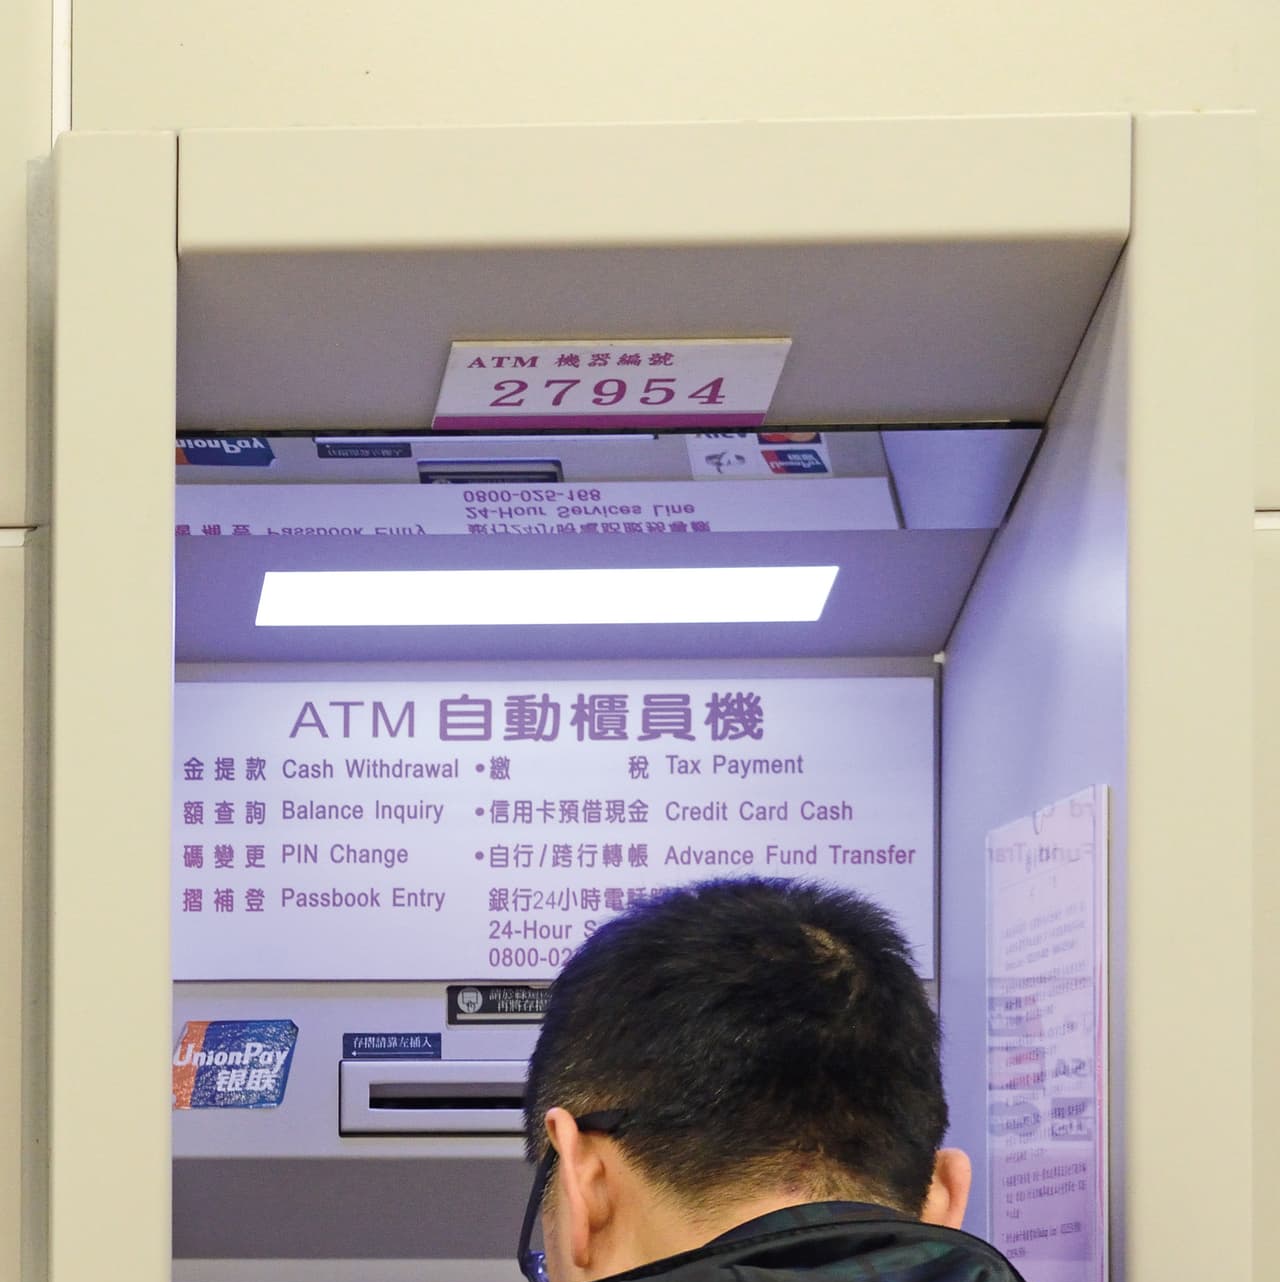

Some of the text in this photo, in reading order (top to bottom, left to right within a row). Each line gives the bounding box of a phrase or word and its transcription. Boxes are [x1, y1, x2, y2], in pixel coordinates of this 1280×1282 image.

[467, 354, 540, 370] ATM
[488, 377, 728, 407] 27954
[289, 692, 764, 742] ATM 自動櫃員機
[282, 758, 333, 779] Cash
[345, 758, 459, 779] Withdrawal
[666, 755, 701, 775] Tax
[713, 755, 804, 779] Payment
[282, 800, 363, 820] Balance
[375, 800, 444, 824] Inquiry
[490, 800, 853, 824] 信用卡預借現金 Credit Card Cash
[282, 845, 318, 863] PIN
[330, 844, 409, 869] Change
[664, 845, 754, 865] Advance
[766, 845, 817, 865] Fund
[829, 845, 916, 865] Transfer
[282, 888, 380, 908] Passbook
[392, 888, 446, 911] Entry
[489, 921, 572, 940] 24-Hour
[173, 1043, 289, 1075] UnionPay
